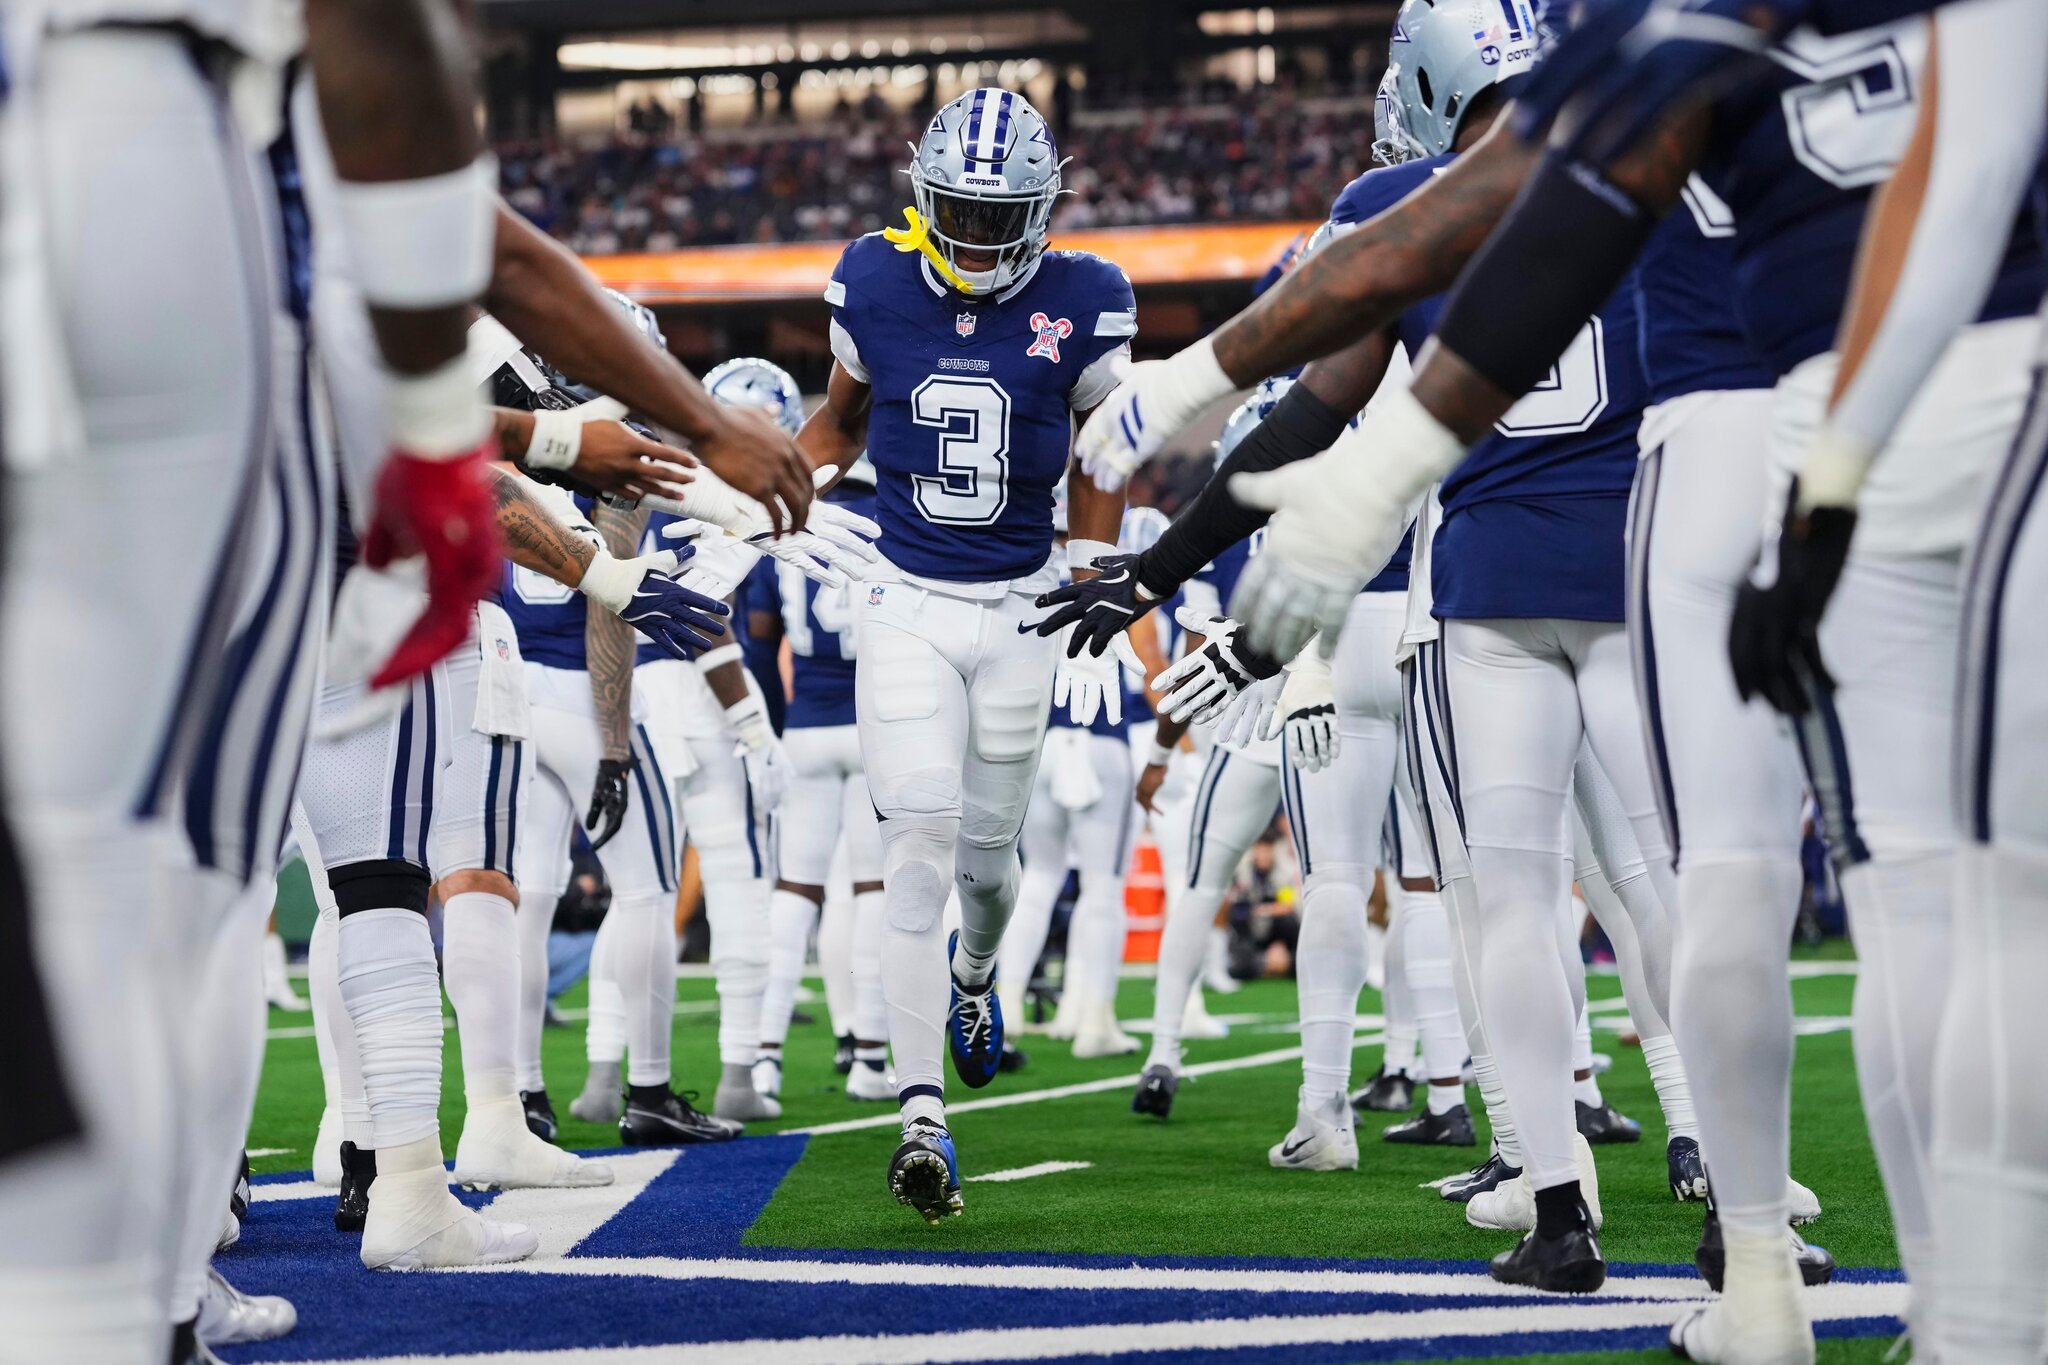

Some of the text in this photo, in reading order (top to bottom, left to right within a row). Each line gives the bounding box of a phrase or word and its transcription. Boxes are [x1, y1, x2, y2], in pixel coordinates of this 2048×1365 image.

[965, 177, 1000, 187] COWBOYS
[958, 322, 972, 332] NFL
[1040, 334, 1055, 347] NFL
[937, 358, 990, 371] COWBOYS
[911, 374, 1012, 526] 3
